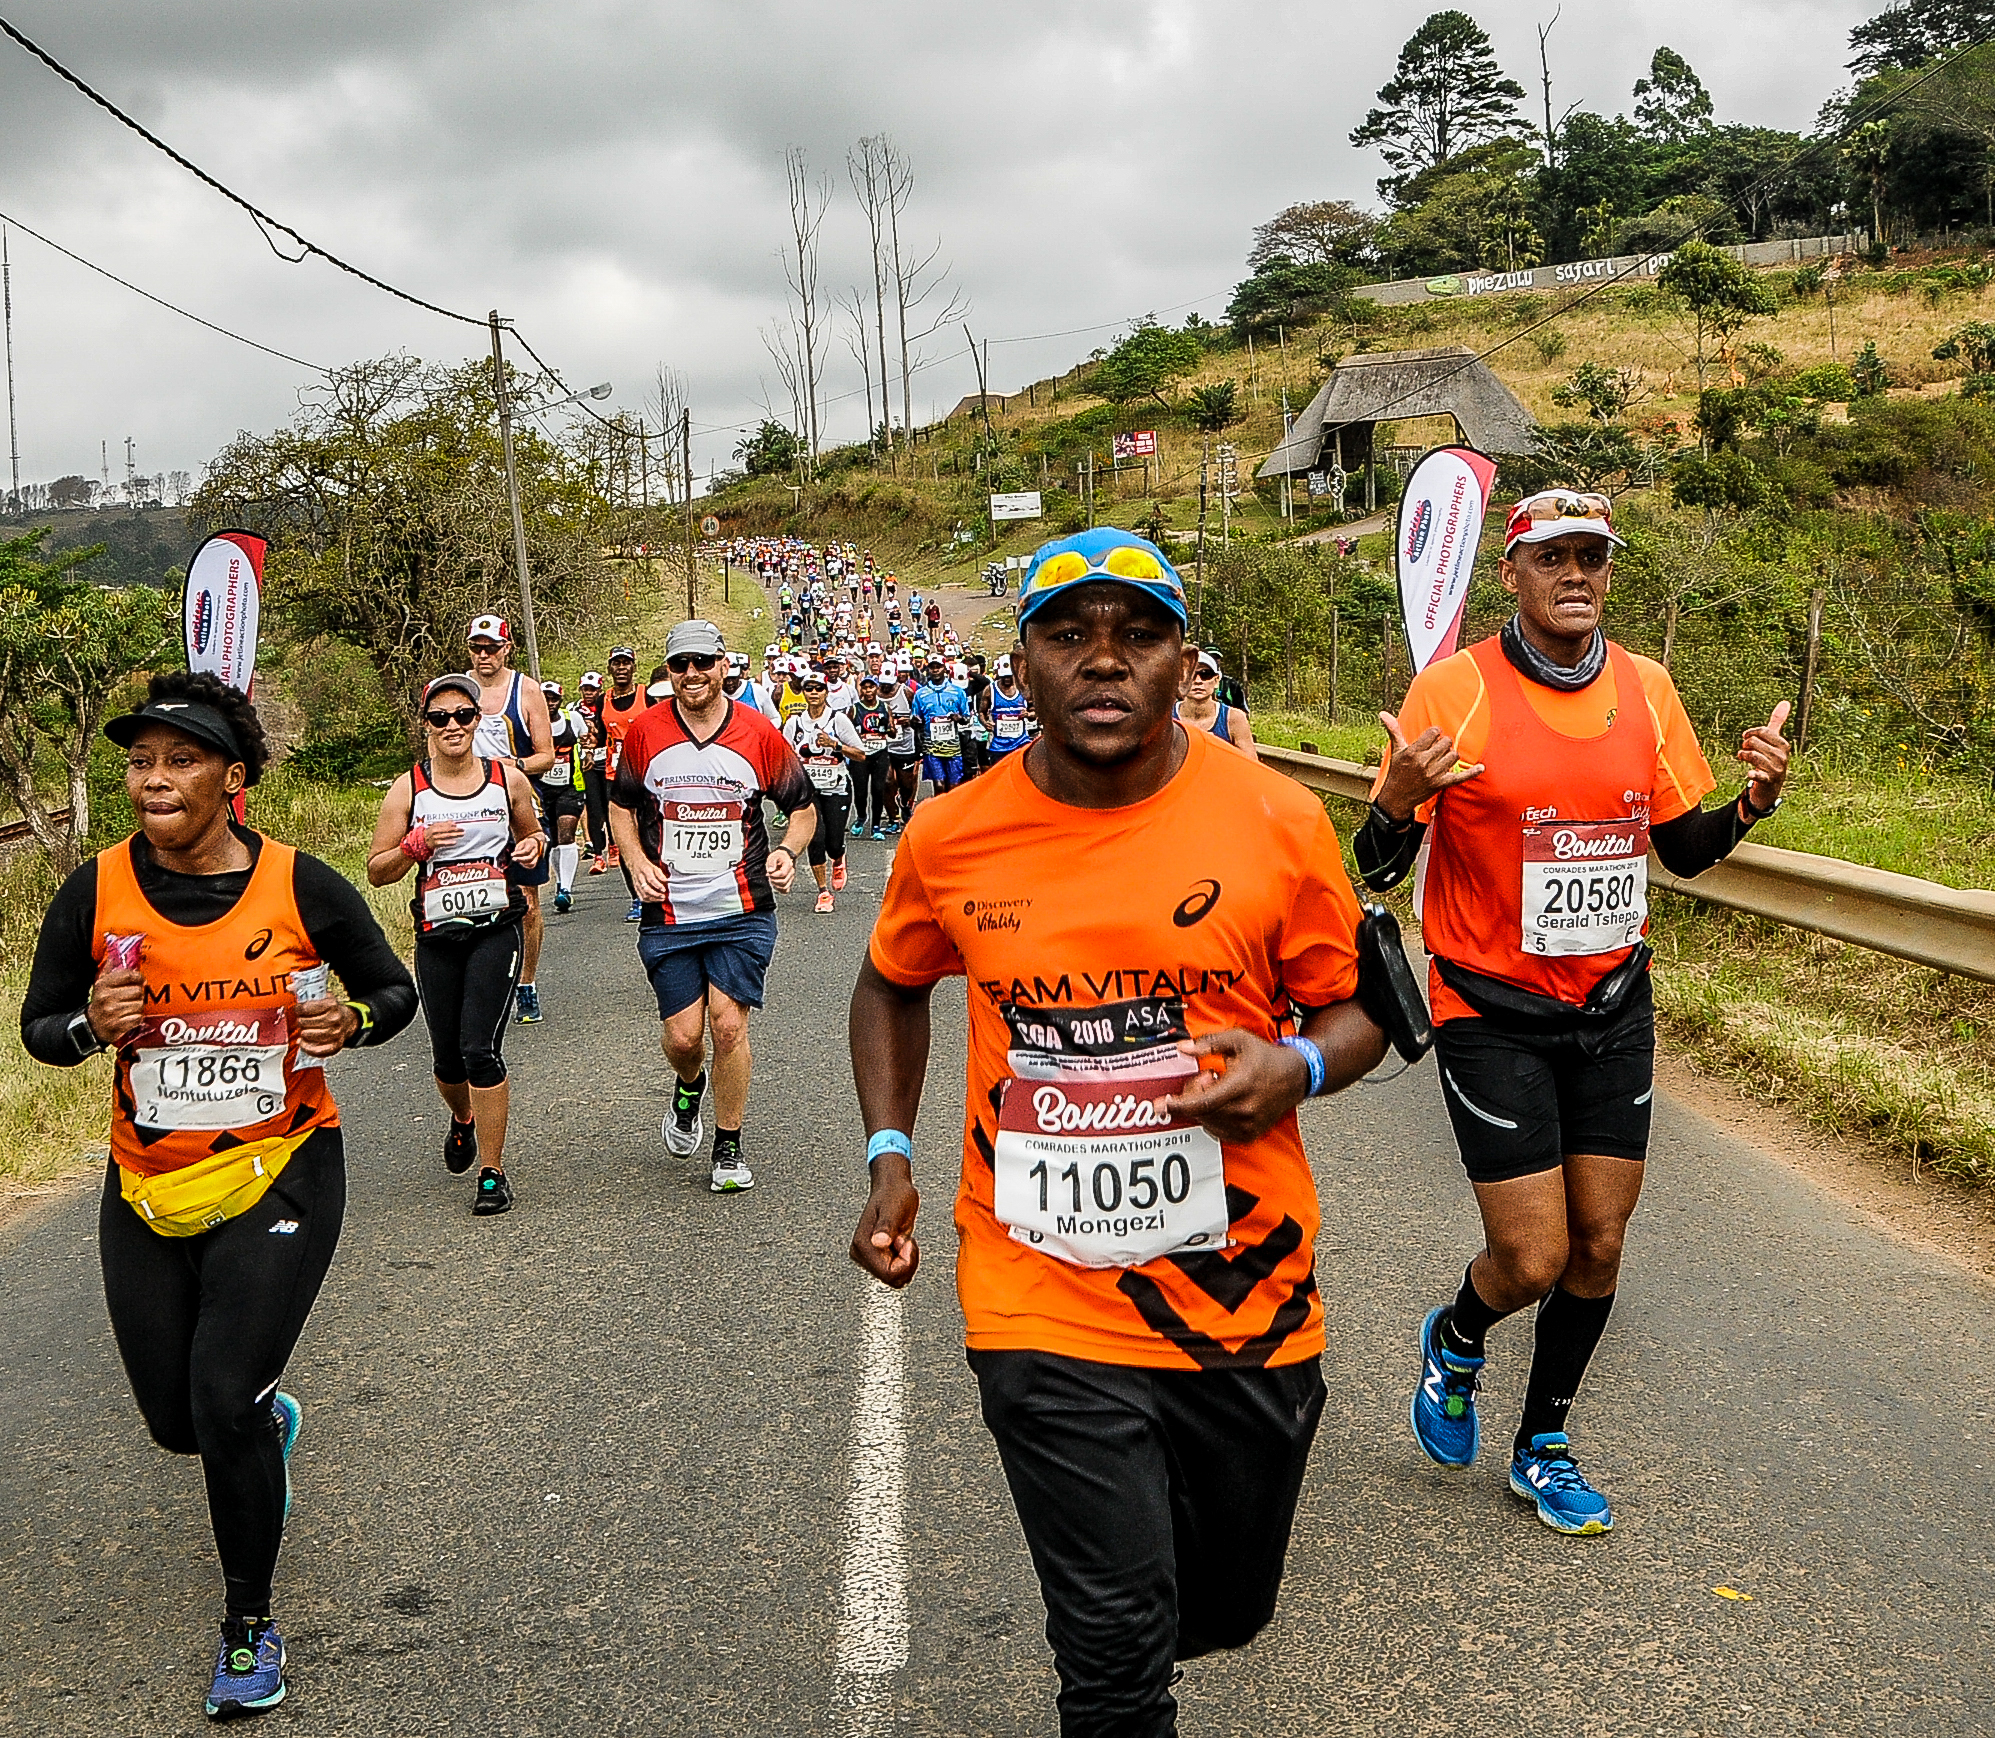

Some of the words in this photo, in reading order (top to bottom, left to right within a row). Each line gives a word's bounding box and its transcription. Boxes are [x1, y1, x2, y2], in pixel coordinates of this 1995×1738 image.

[1555, 259, 1616, 283] safari
[1647, 254, 1675, 275] pa
[704, 521, 716, 531] 60
[1424, 572, 1446, 631] OFFICIAL
[1436, 475, 1467, 576] PHOTOGRAPHERS
[222, 558, 240, 661] PHOTOGRAPHERS
[664, 775, 716, 784] BRIMSTONE
[426, 810, 480, 820] BRIMSTONE
[677, 803, 728, 820] Bonitas
[673, 829, 731, 850] 17799
[1552, 829, 1635, 860] Bonitas
[690, 850, 713, 858] Jack
[437, 867, 490, 886] Bonitas
[1588, 863, 1626, 872] MARATHON
[442, 888, 491, 912] 6012
[977, 898, 1033, 912] Discovery
[1543, 873, 1635, 914] 20580
[976, 911, 1021, 934] Vitality
[1536, 913, 1590, 929] Gerald
[1593, 910, 1639, 926] Tshepo
[1535, 936, 1546, 952] 5
[180, 972, 291, 1002] VITALIT
[1081, 968, 1245, 1000] VITALITY
[159, 1018, 260, 1045] Bonitas
[1070, 1018, 1115, 1045] 2018
[1125, 1006, 1171, 1031] ASA
[148, 1105, 159, 1123] 2
[256, 1094, 274, 1115] G
[1025, 1139, 1087, 1154] COMRADES
[1090, 1138, 1162, 1154] MARATHON
[1165, 1133, 1191, 1146] 2018
[1029, 1152, 1191, 1213] 11050
[1056, 1209, 1165, 1237] Mongezi
